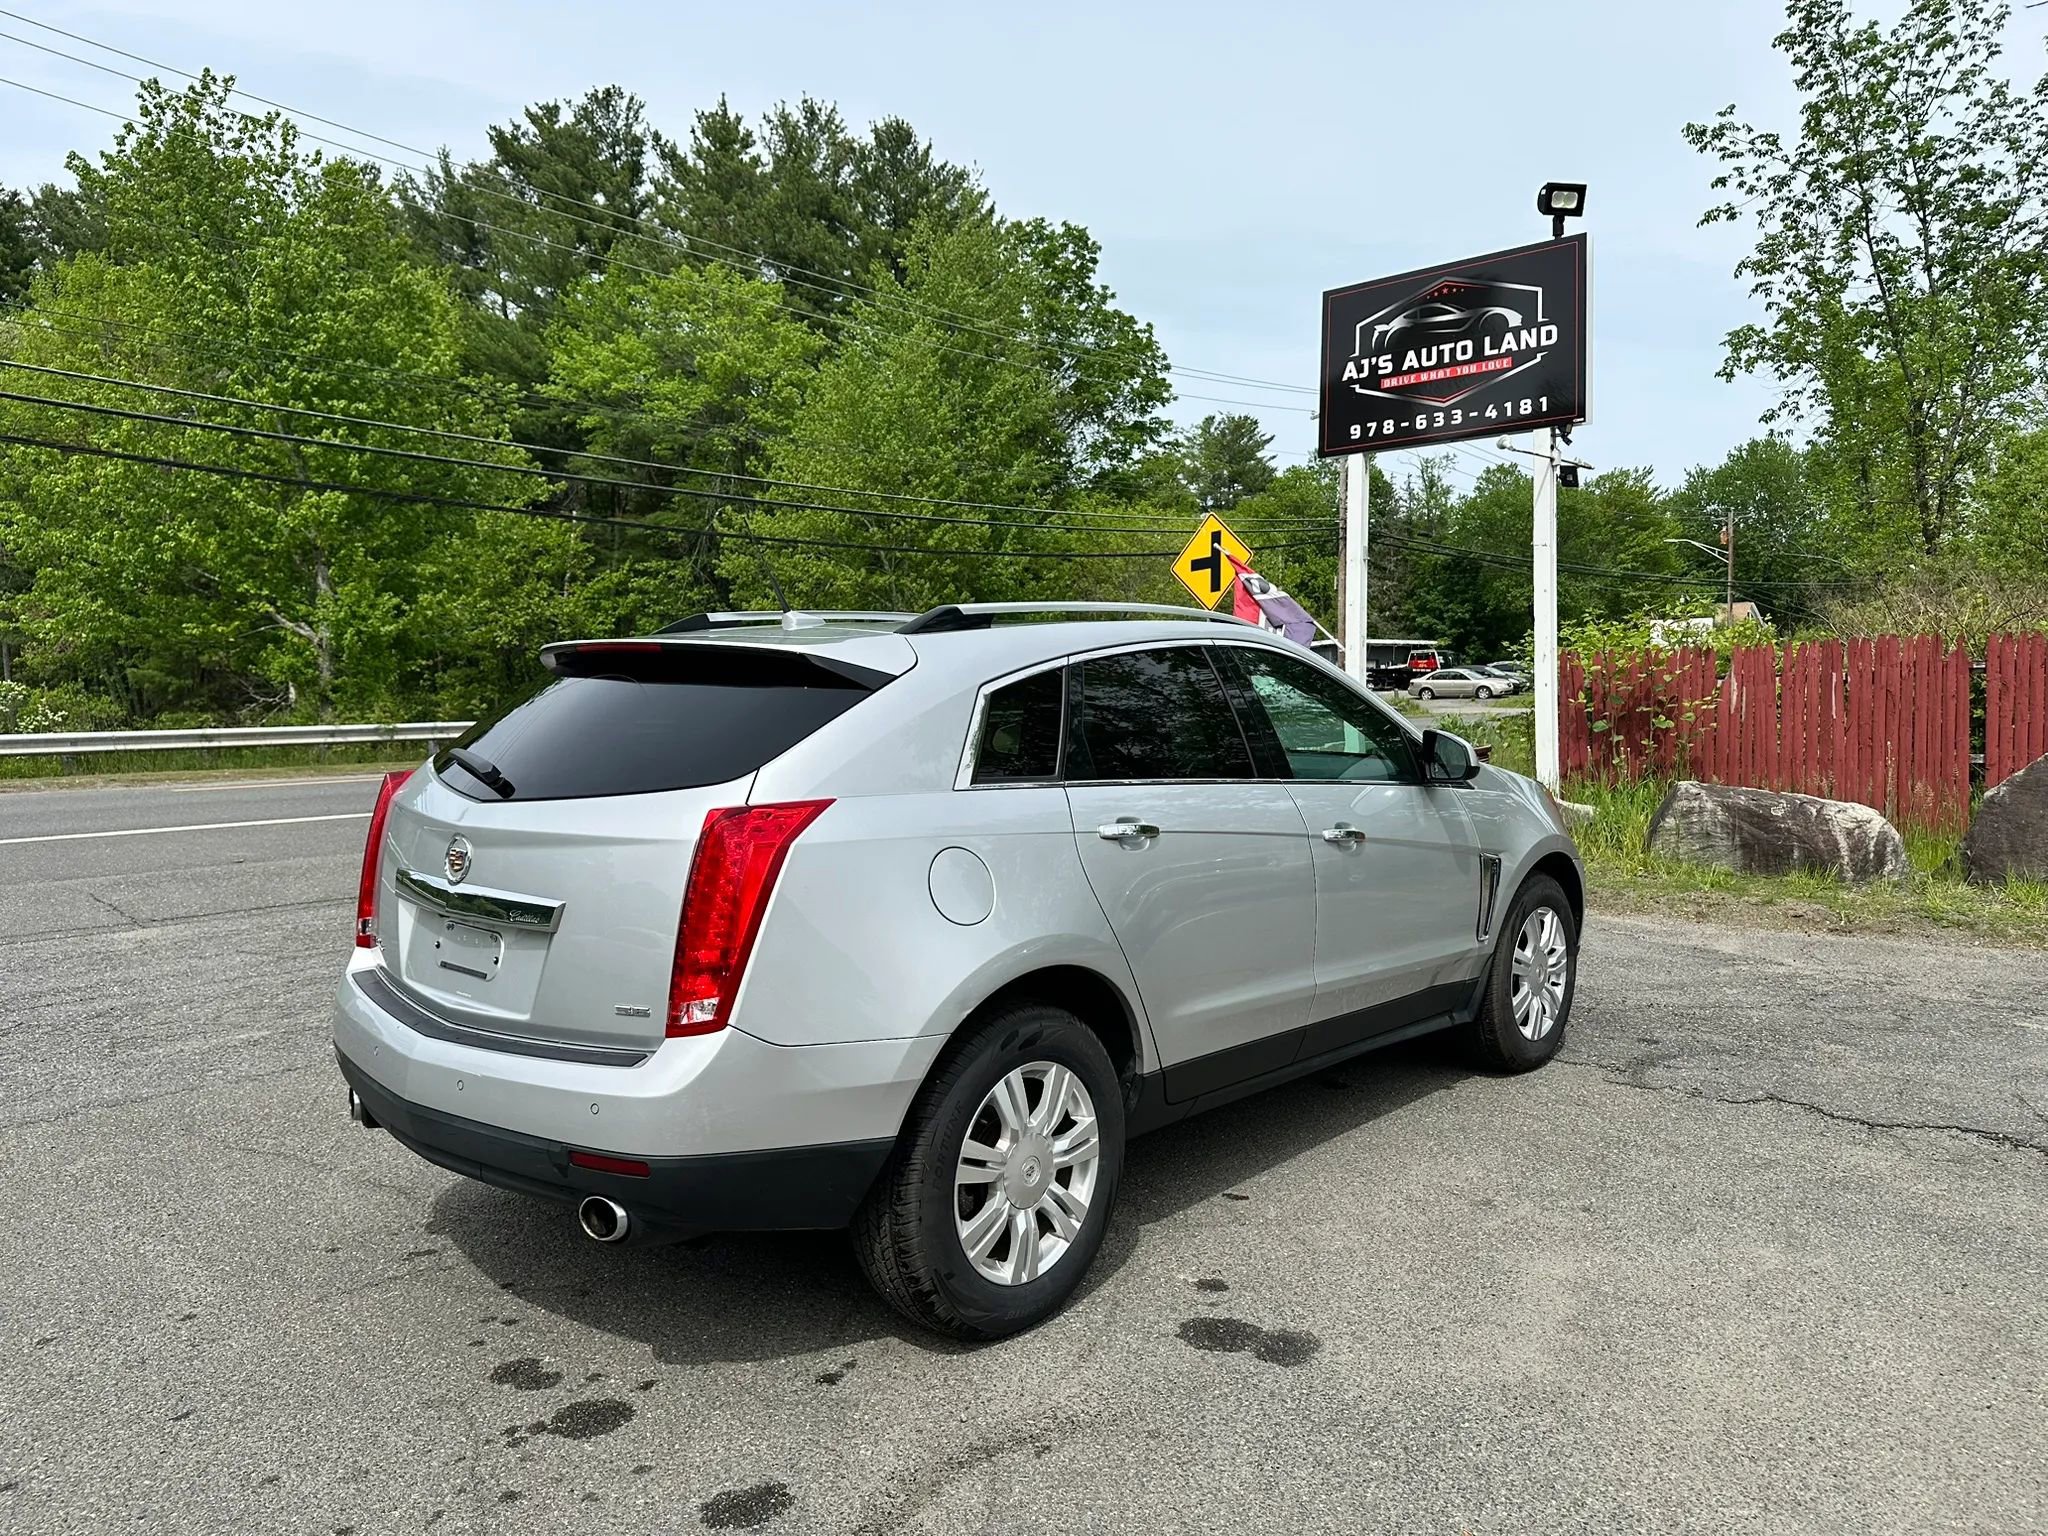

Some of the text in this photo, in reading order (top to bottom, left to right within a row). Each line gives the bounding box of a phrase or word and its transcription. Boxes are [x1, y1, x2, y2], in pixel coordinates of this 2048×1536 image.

[1342, 324, 1558, 381] AJ'S AUTO LAND
[1383, 358, 1510, 388] DRIVE WHAT YOU LOVE
[1350, 396, 1549, 439] 978-633-4181
[509, 909, 540, 924] Cadillac
